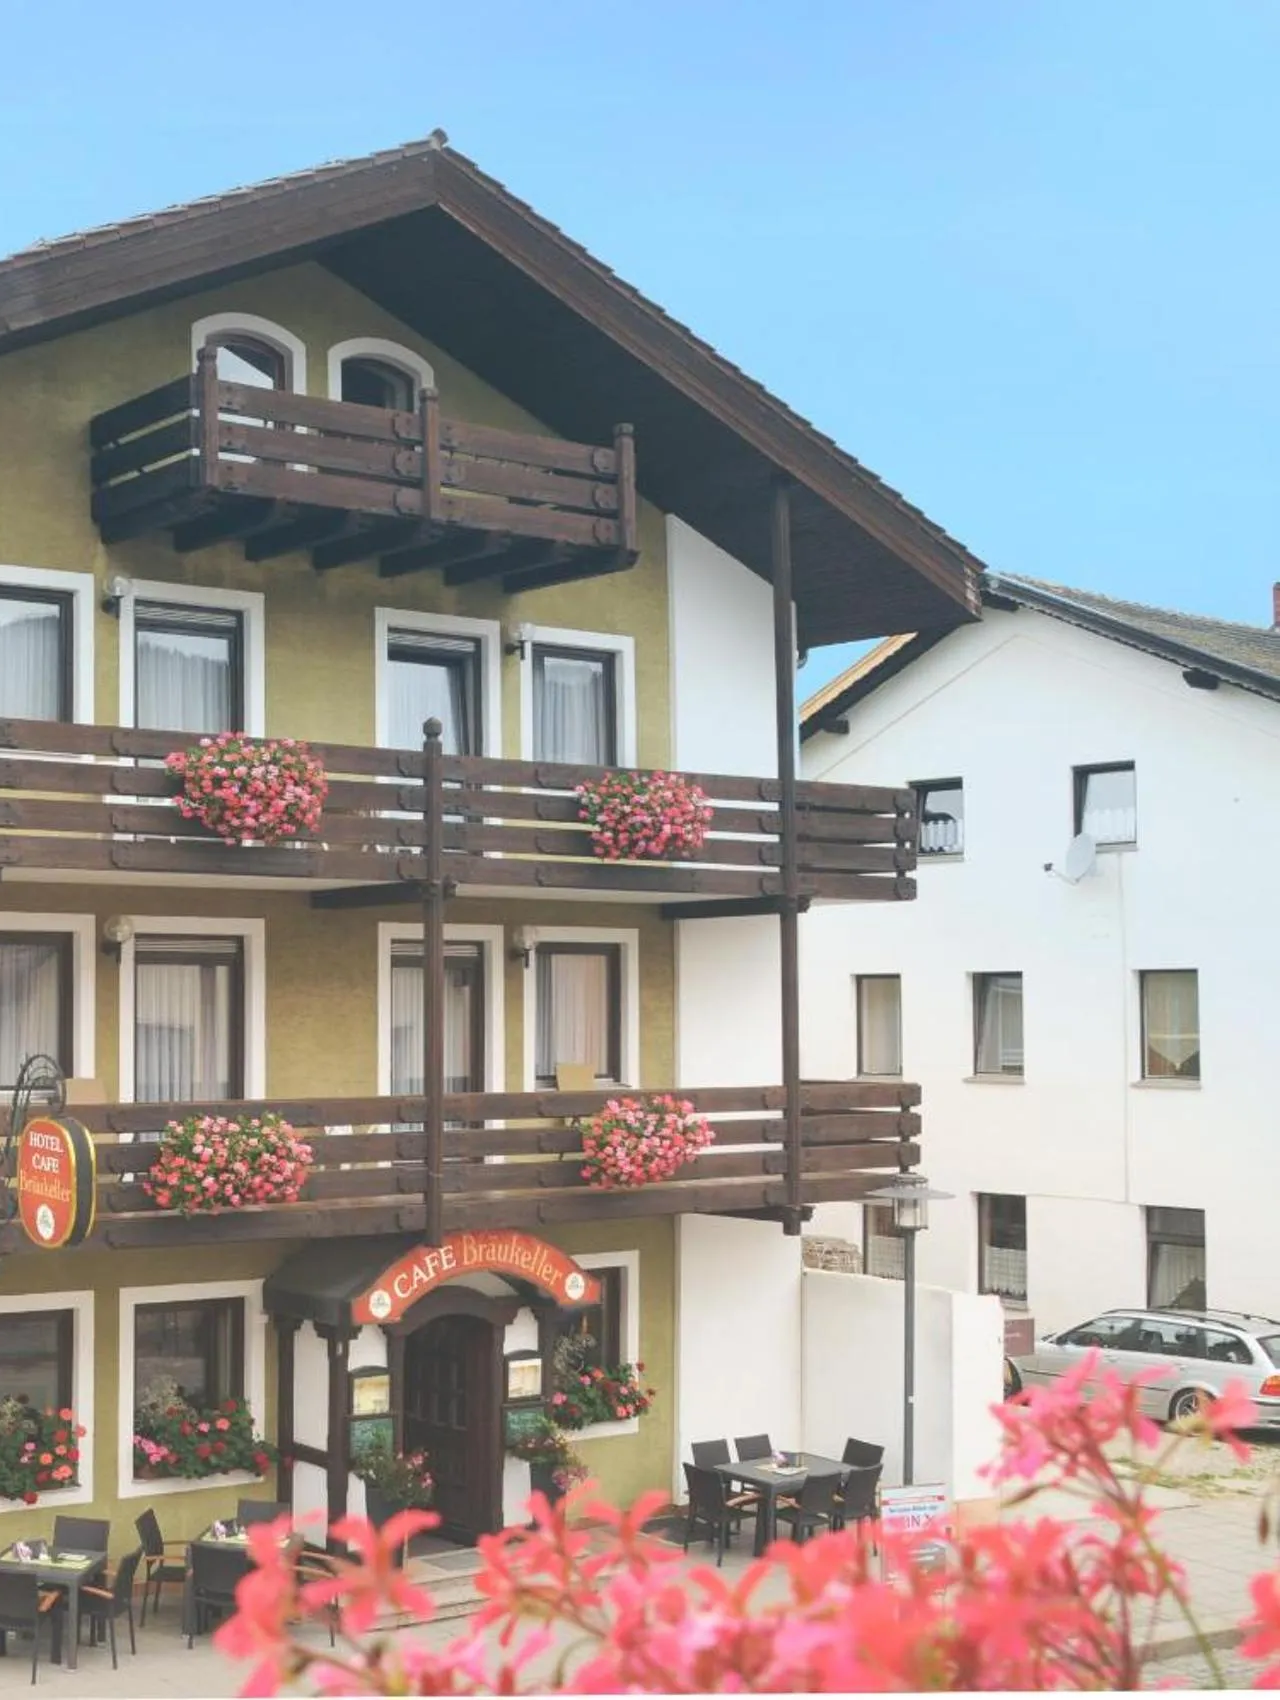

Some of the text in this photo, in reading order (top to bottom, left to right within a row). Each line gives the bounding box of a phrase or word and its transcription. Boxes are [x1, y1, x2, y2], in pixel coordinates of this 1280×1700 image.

[29, 1130, 64, 1153] HOTEL
[32, 1153, 60, 1173] CAFE
[394, 1235, 563, 1299] CAFE Bräukeller
